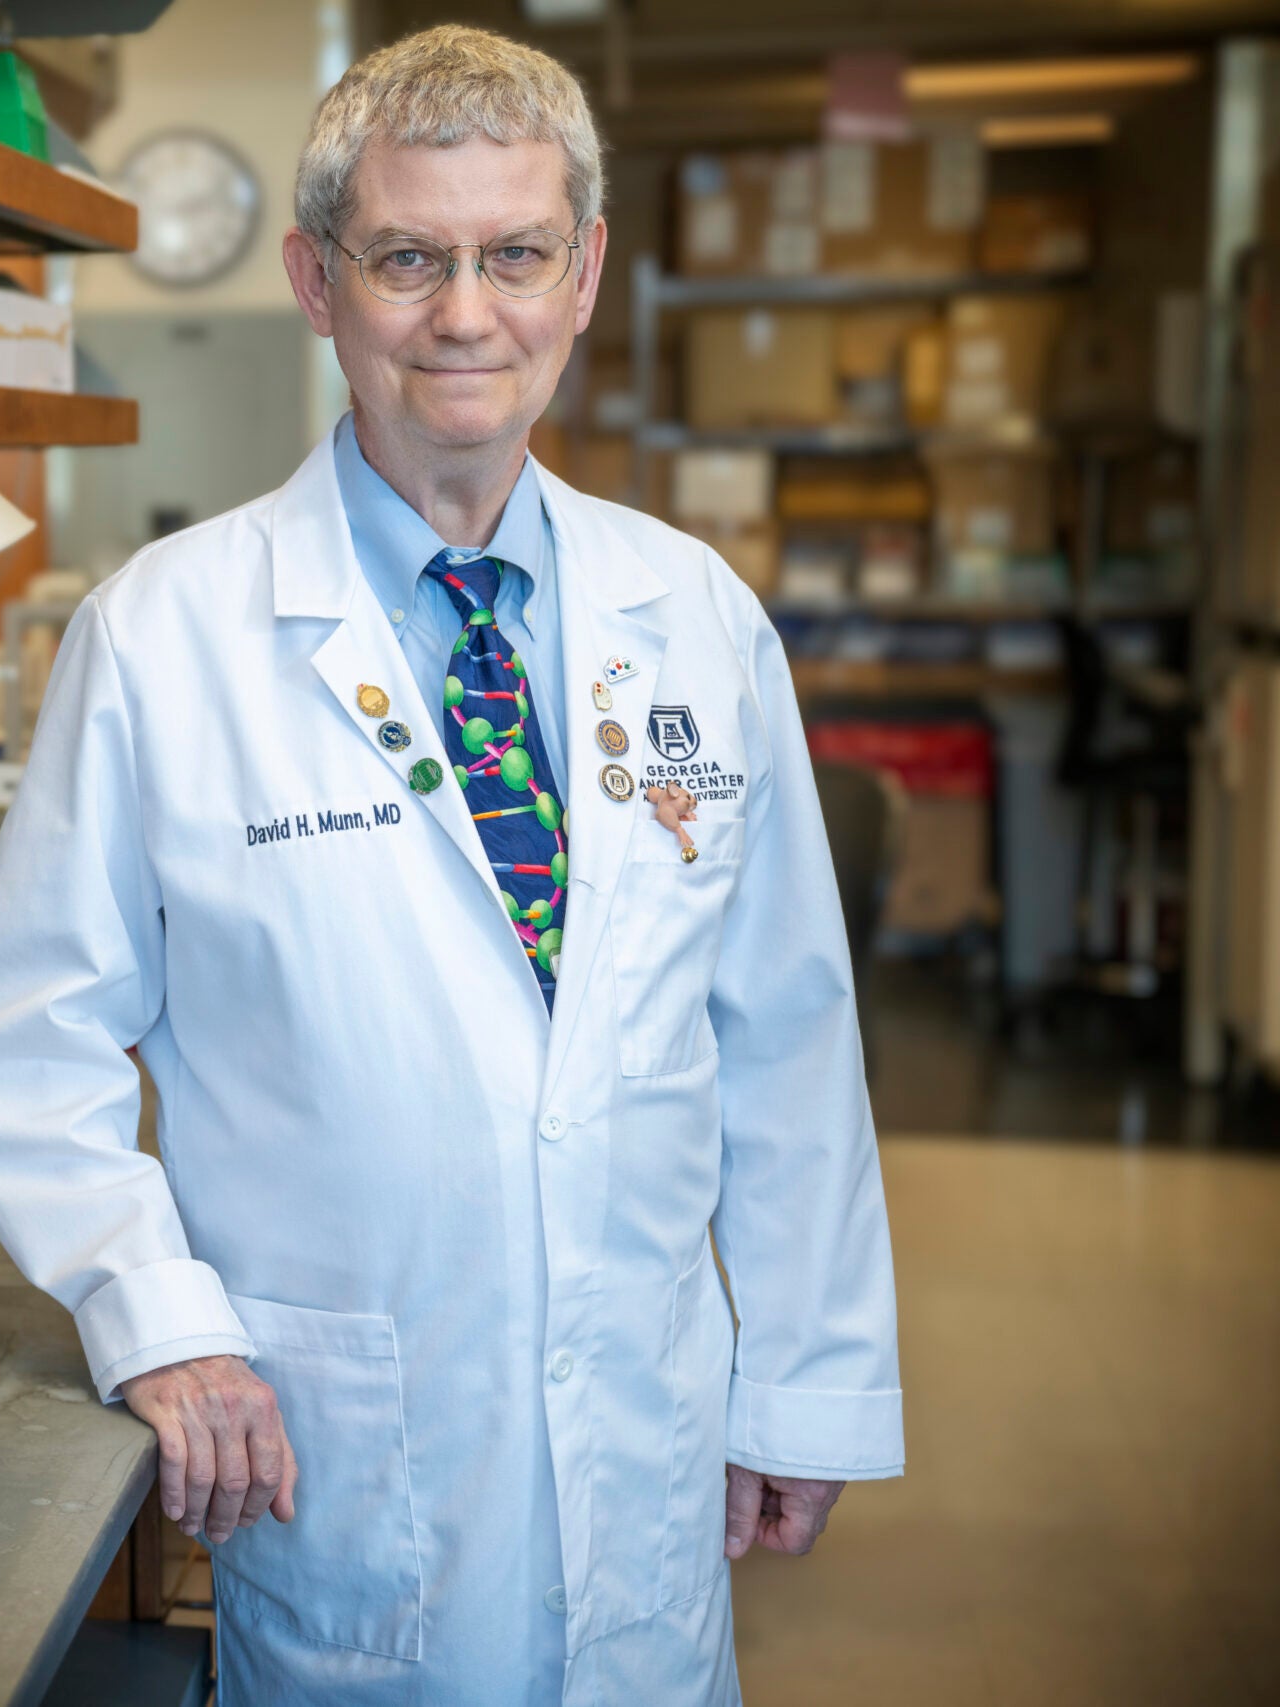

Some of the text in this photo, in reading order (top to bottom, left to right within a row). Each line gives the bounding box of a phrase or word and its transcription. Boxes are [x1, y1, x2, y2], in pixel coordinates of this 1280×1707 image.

[646, 761, 721, 777] GEORGIA
[639, 774, 745, 790] ANCR CENTER
[694, 789, 738, 801] IVERSITY
[246, 803, 402, 847] David H. Munn, MD
